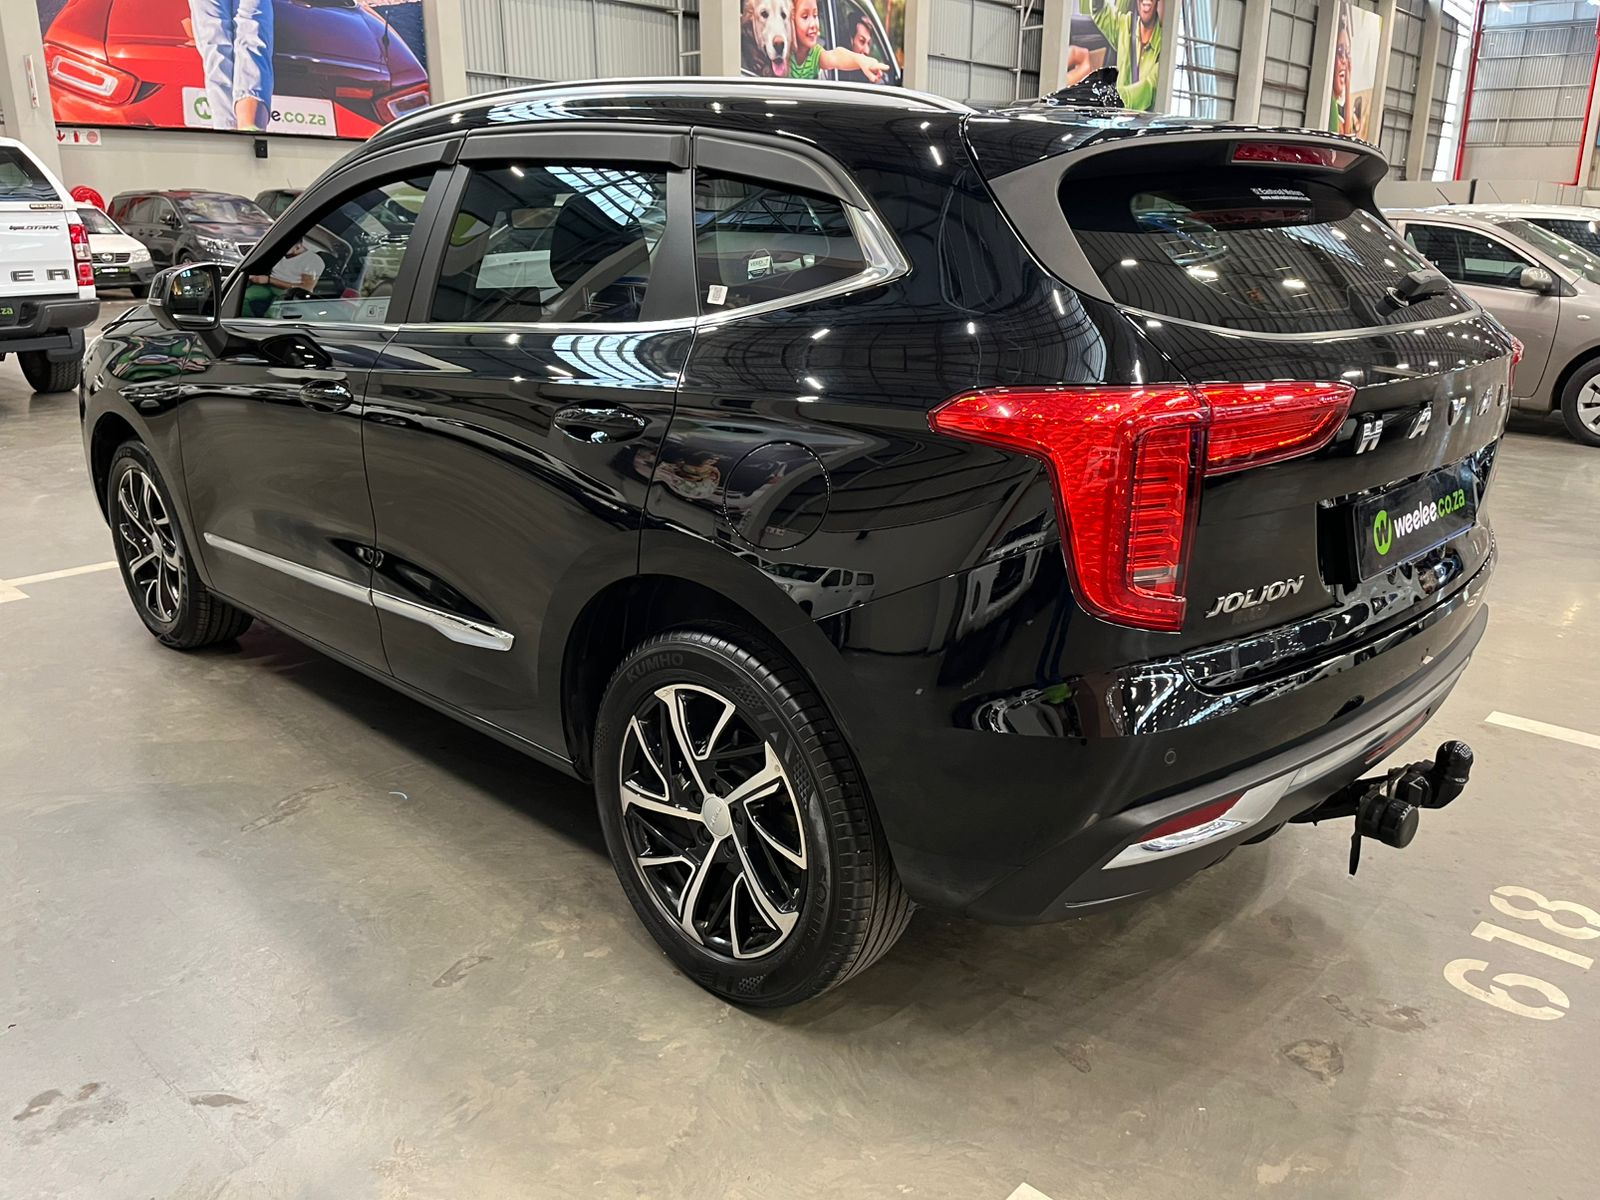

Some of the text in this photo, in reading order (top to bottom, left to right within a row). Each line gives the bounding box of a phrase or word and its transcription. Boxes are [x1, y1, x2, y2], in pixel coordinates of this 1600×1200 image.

[1394, 488, 1466, 539] weelee.co.za
[1204, 575, 1305, 619] JOLION
[626, 653, 684, 683] KUMHO
[1443, 885, 1600, 1021] 618
